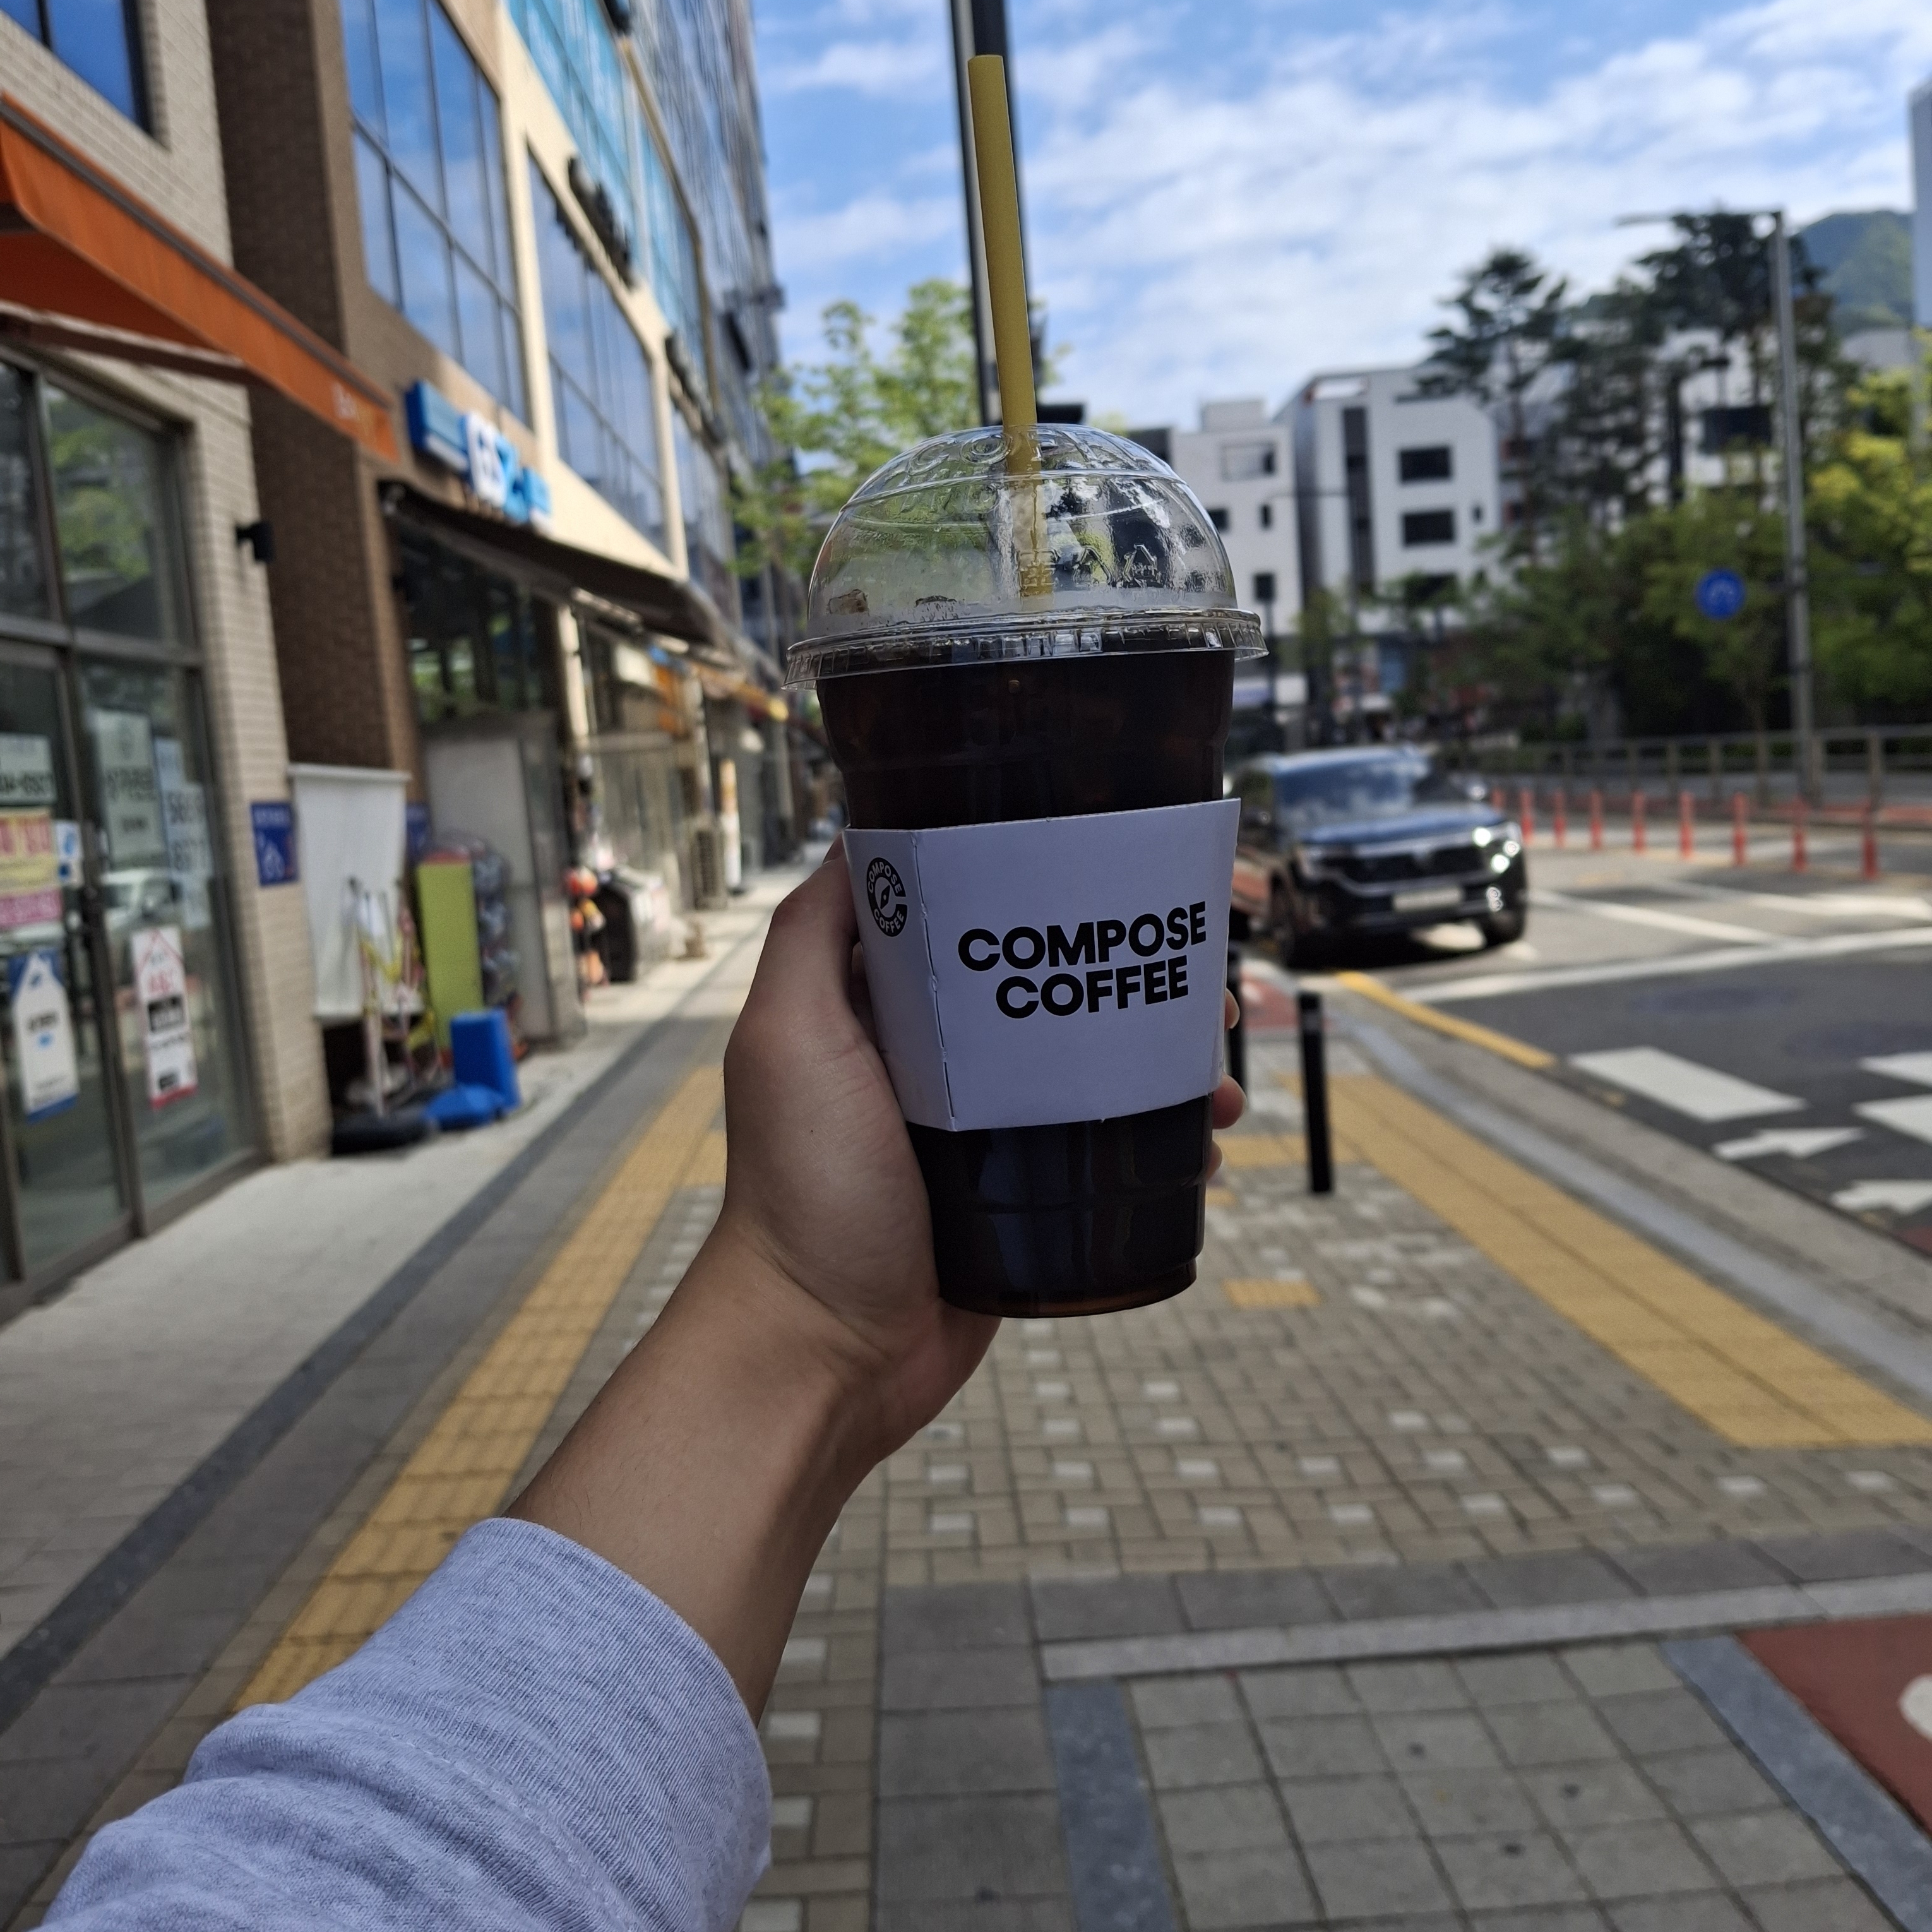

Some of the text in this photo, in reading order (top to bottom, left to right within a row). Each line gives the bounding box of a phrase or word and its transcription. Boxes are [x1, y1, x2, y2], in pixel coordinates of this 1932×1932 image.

[868, 861, 902, 893] COMPOSE
[874, 909, 904, 933] COFFEE
[958, 900, 1207, 972] COMPOSE
[996, 955, 1189, 1019] COFFEE
